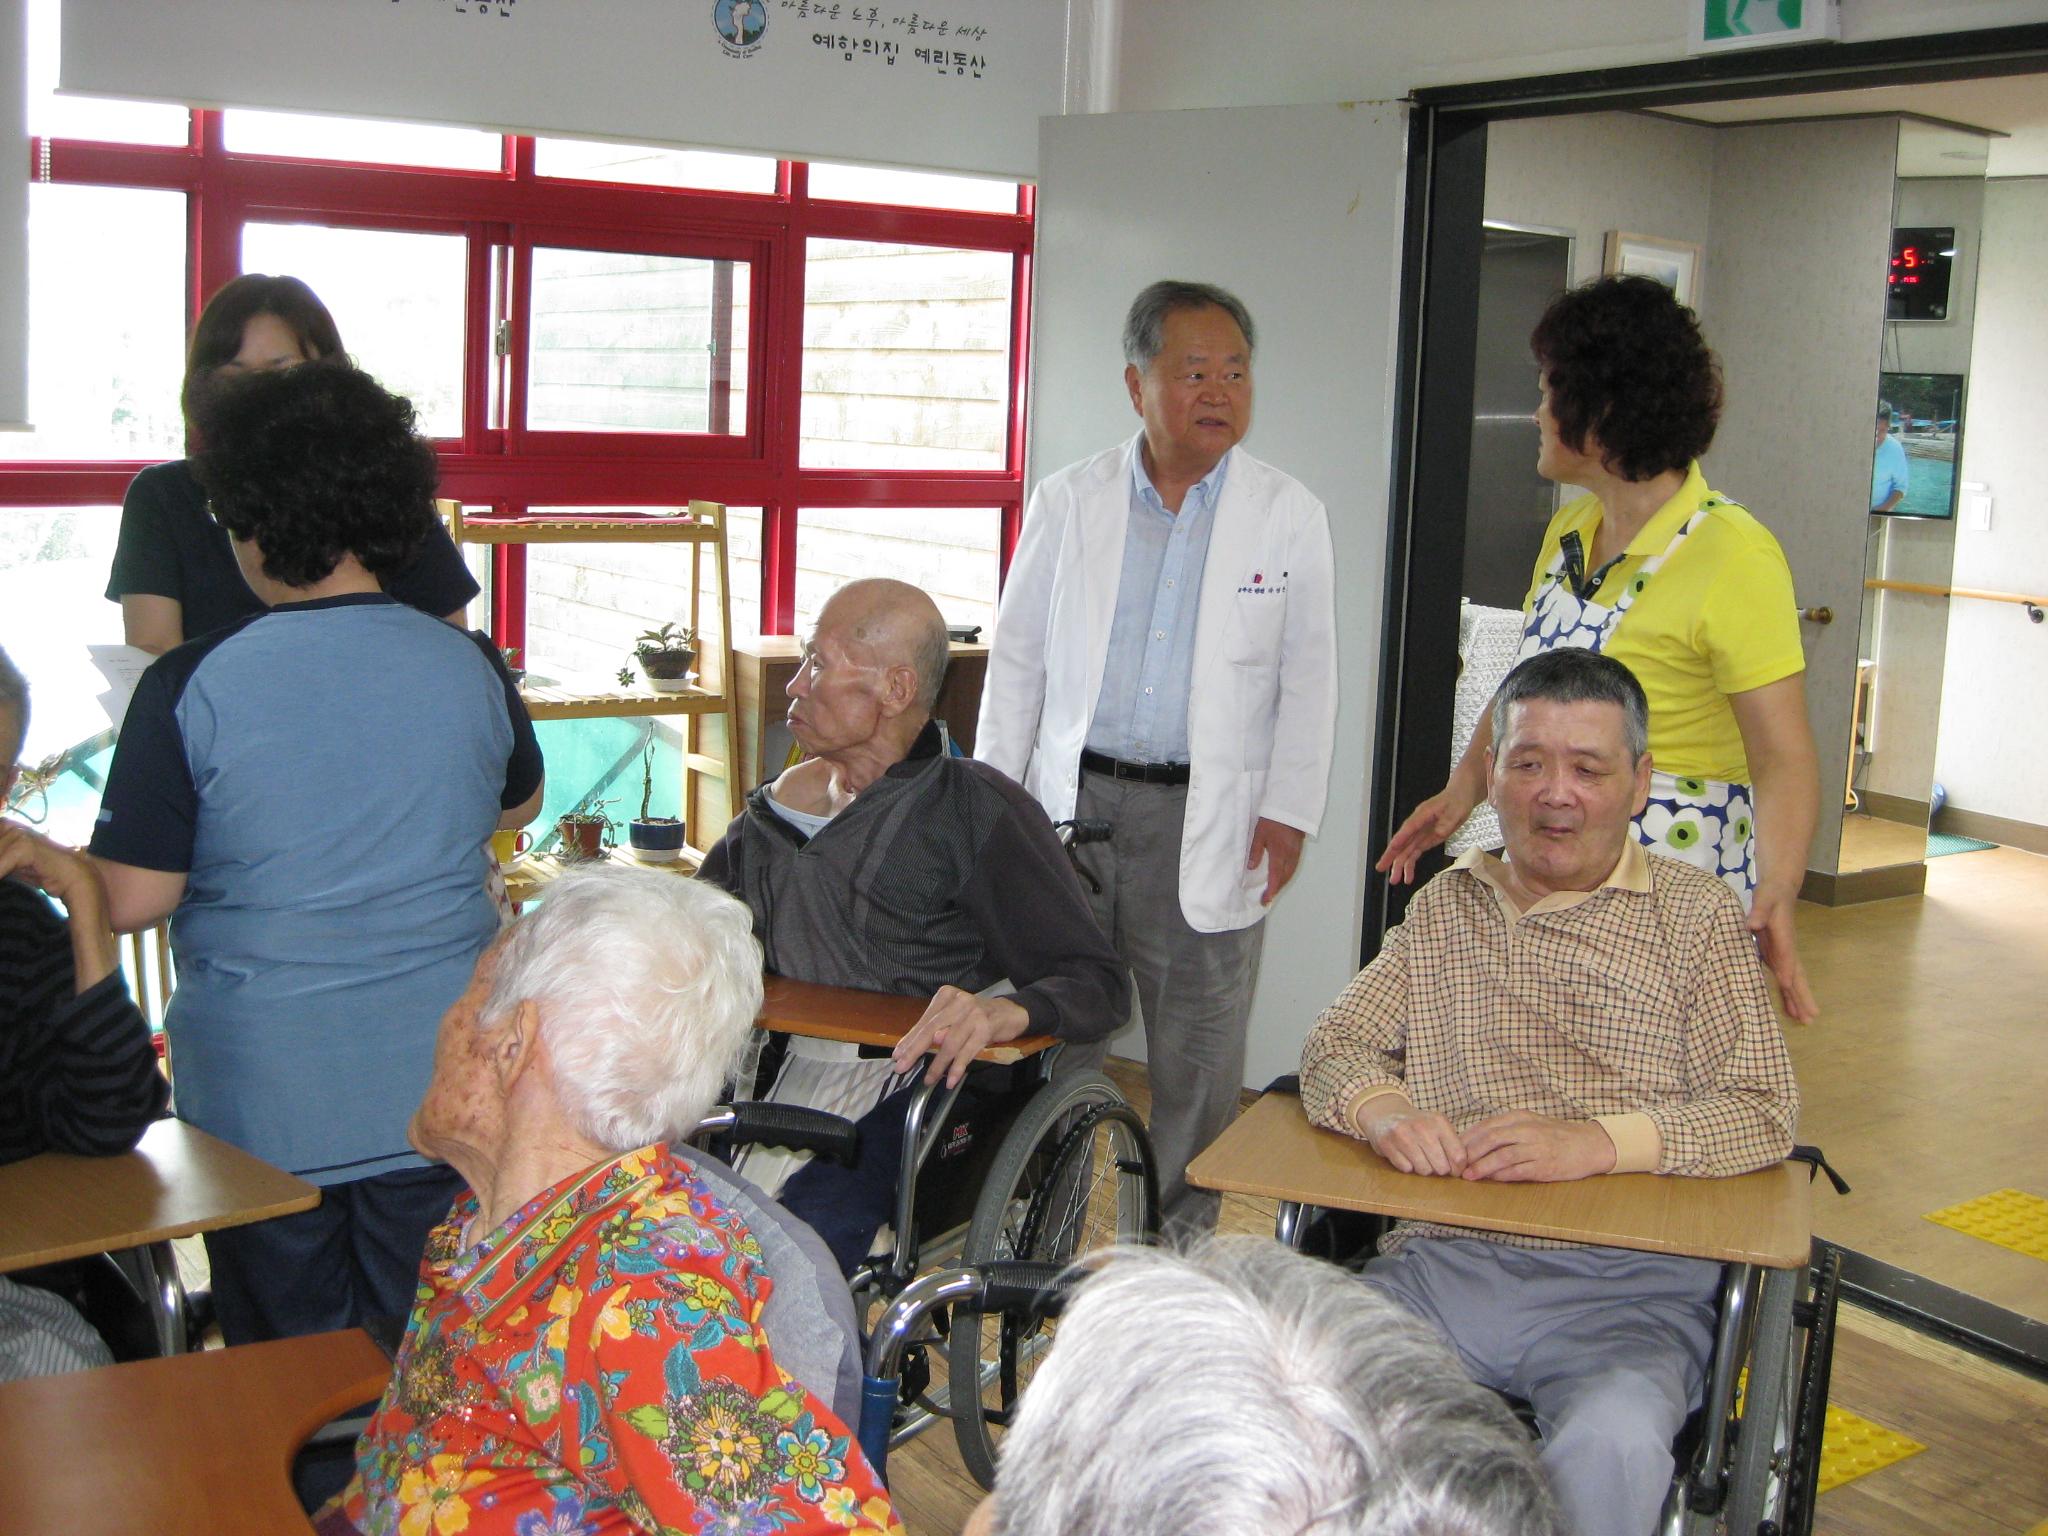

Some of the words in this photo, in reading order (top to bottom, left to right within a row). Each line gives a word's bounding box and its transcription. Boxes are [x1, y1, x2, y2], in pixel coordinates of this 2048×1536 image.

[781, 0, 841, 21] 아름다운
[852, 7, 885, 28] 노후,
[892, 13, 949, 36] 아름다운
[955, 26, 988, 41] 세상
[812, 33, 899, 66] 예함의집
[914, 48, 987, 79] 예린동산
